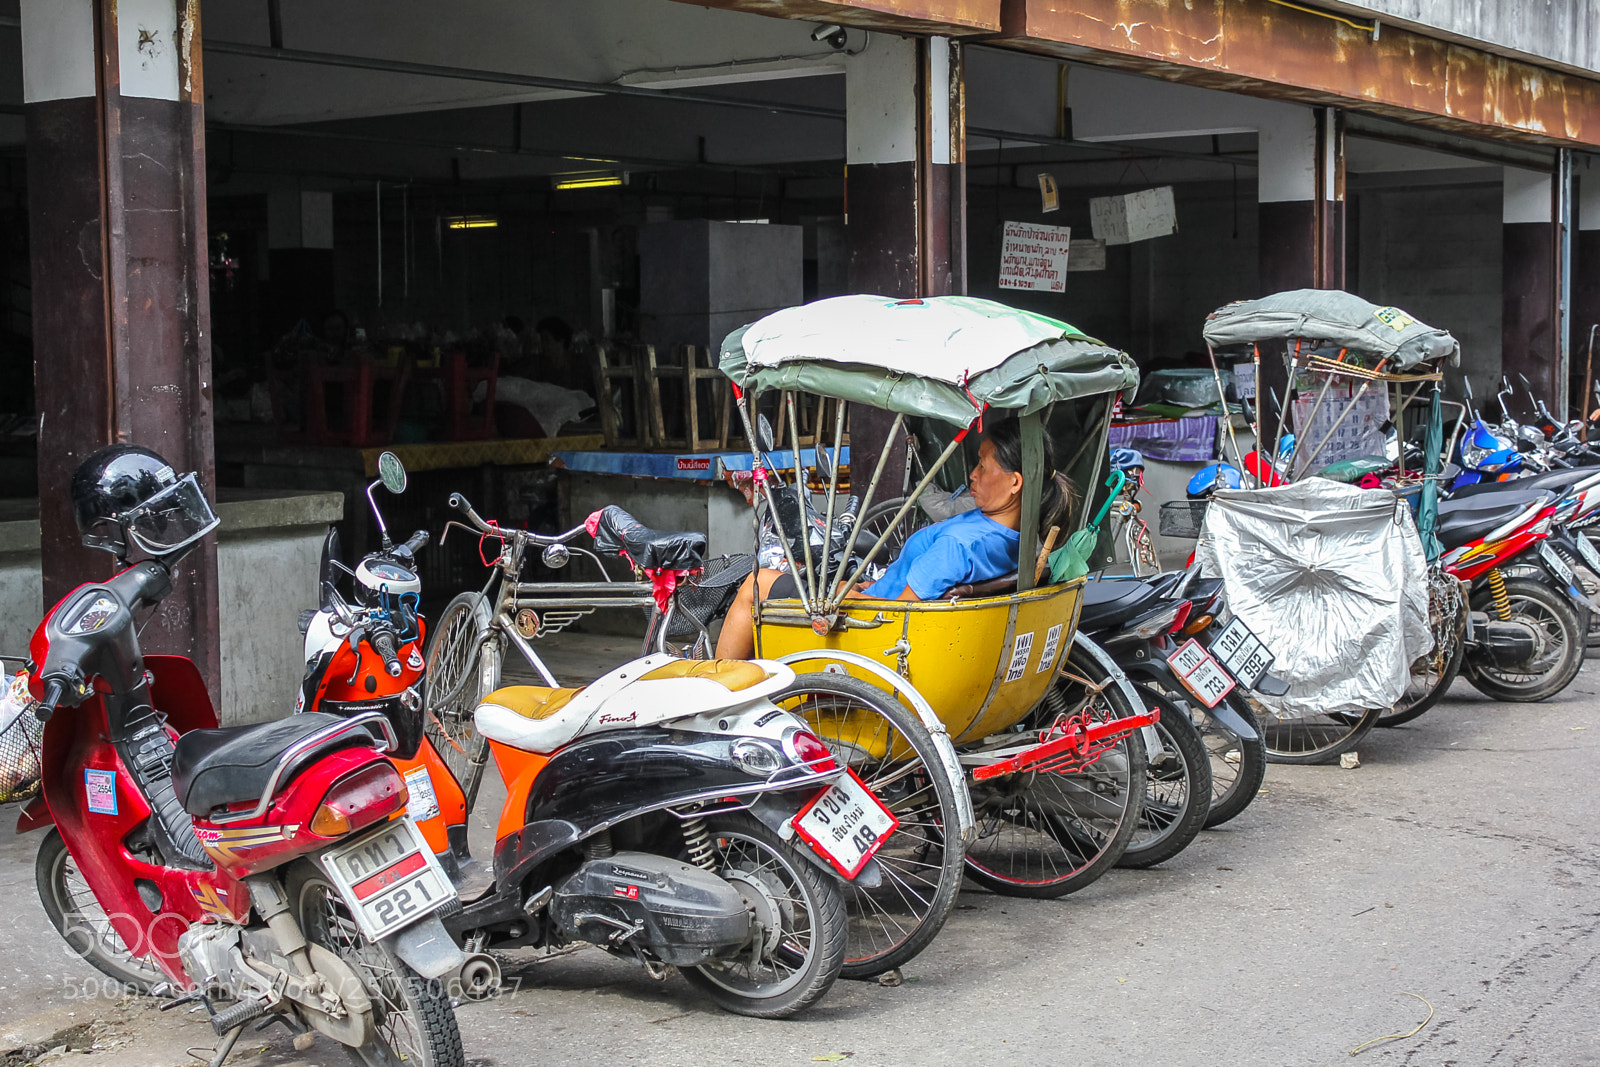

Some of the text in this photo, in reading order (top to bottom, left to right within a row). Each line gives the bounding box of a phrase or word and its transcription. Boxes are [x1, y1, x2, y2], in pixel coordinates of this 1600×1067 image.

[1244, 653, 1266, 679] 992
[1204, 676, 1226, 698] 733
[97, 784, 112, 793] 2554
[832, 803, 865, 842] เชียงใหม่
[852, 824, 878, 854] 48
[375, 880, 432, 926] 221
[628, 888, 638, 897] AT
